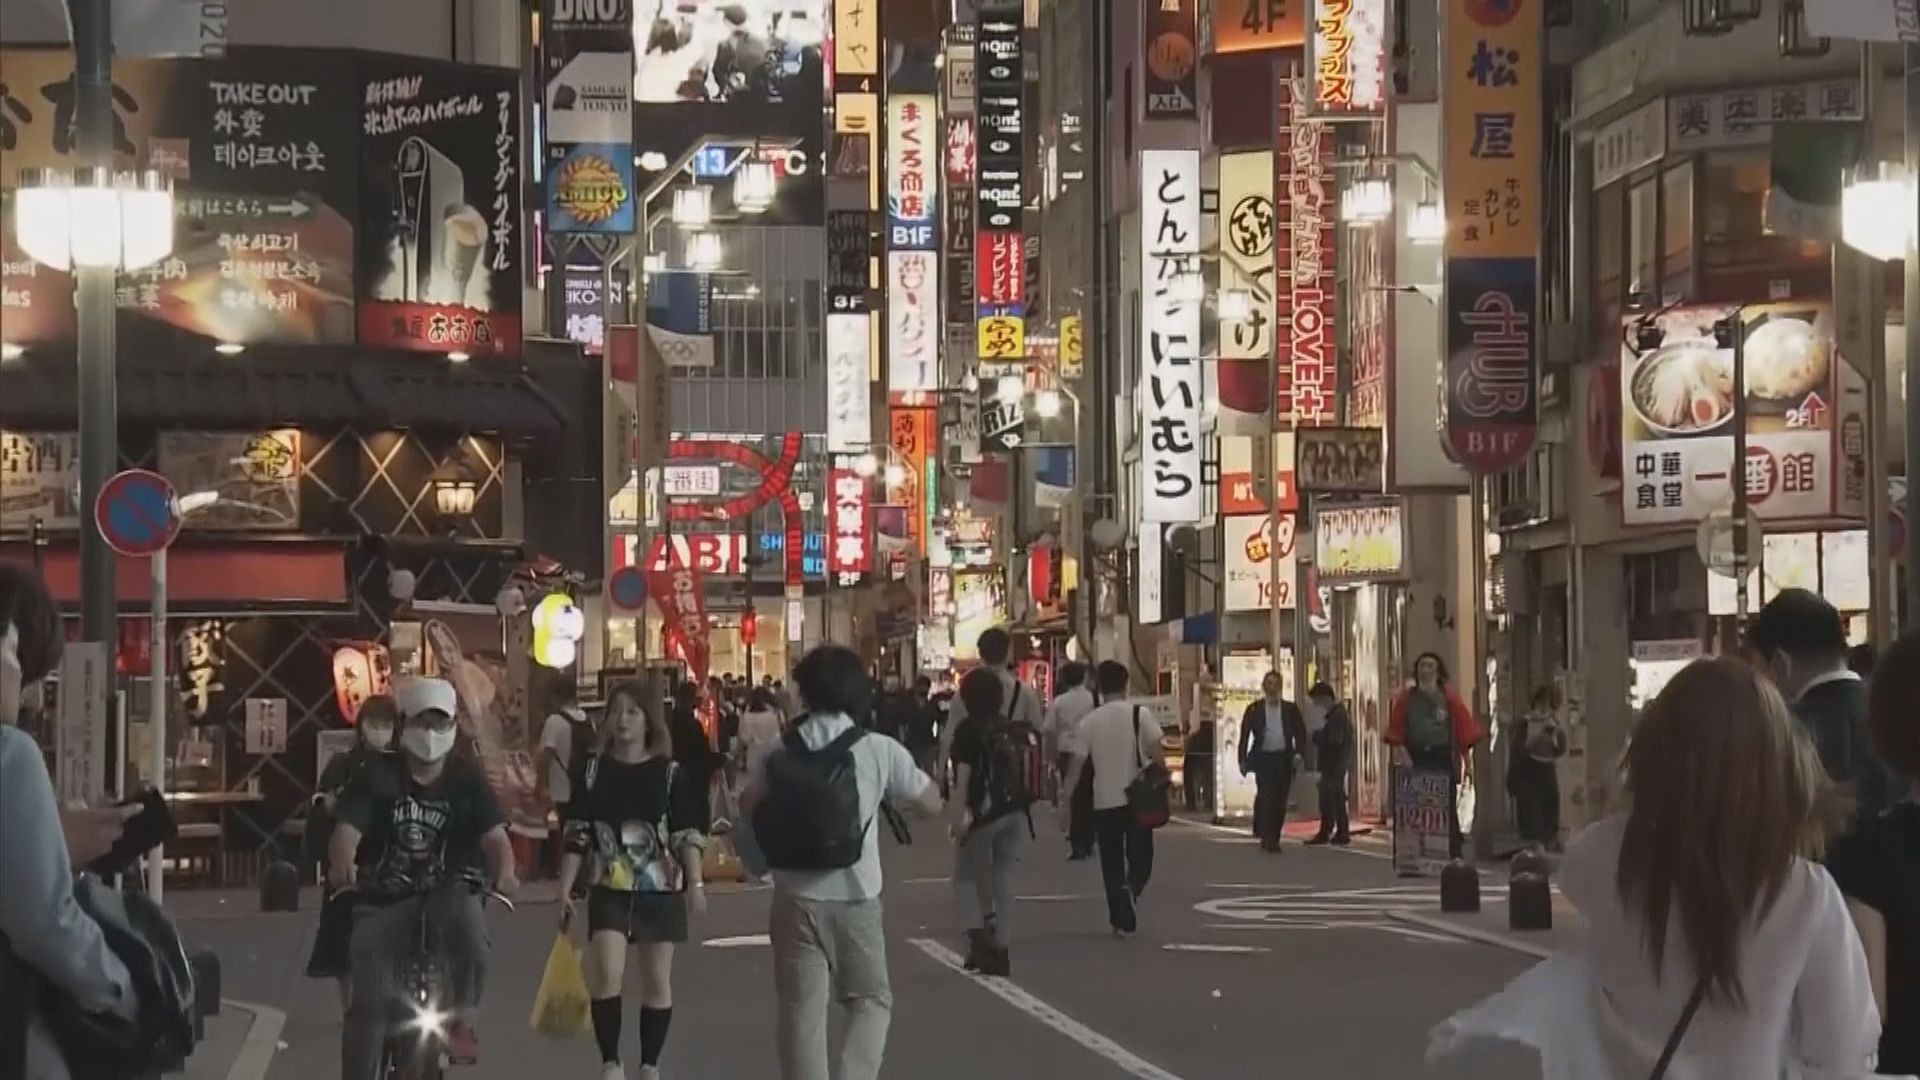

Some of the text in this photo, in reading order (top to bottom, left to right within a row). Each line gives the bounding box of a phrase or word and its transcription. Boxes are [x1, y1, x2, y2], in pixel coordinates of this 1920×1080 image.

[1154, 96, 1182, 108] 入口
[1467, 40, 1521, 160] 松屋
[1484, 187, 1500, 236] カレー
[1504, 176, 1521, 228] 牛めし
[892, 227, 932, 246] B1F
[1467, 432, 1519, 453] B1F
[1636, 451, 1816, 504] 中華 一番館
[1636, 483, 1691, 508] 食堂
